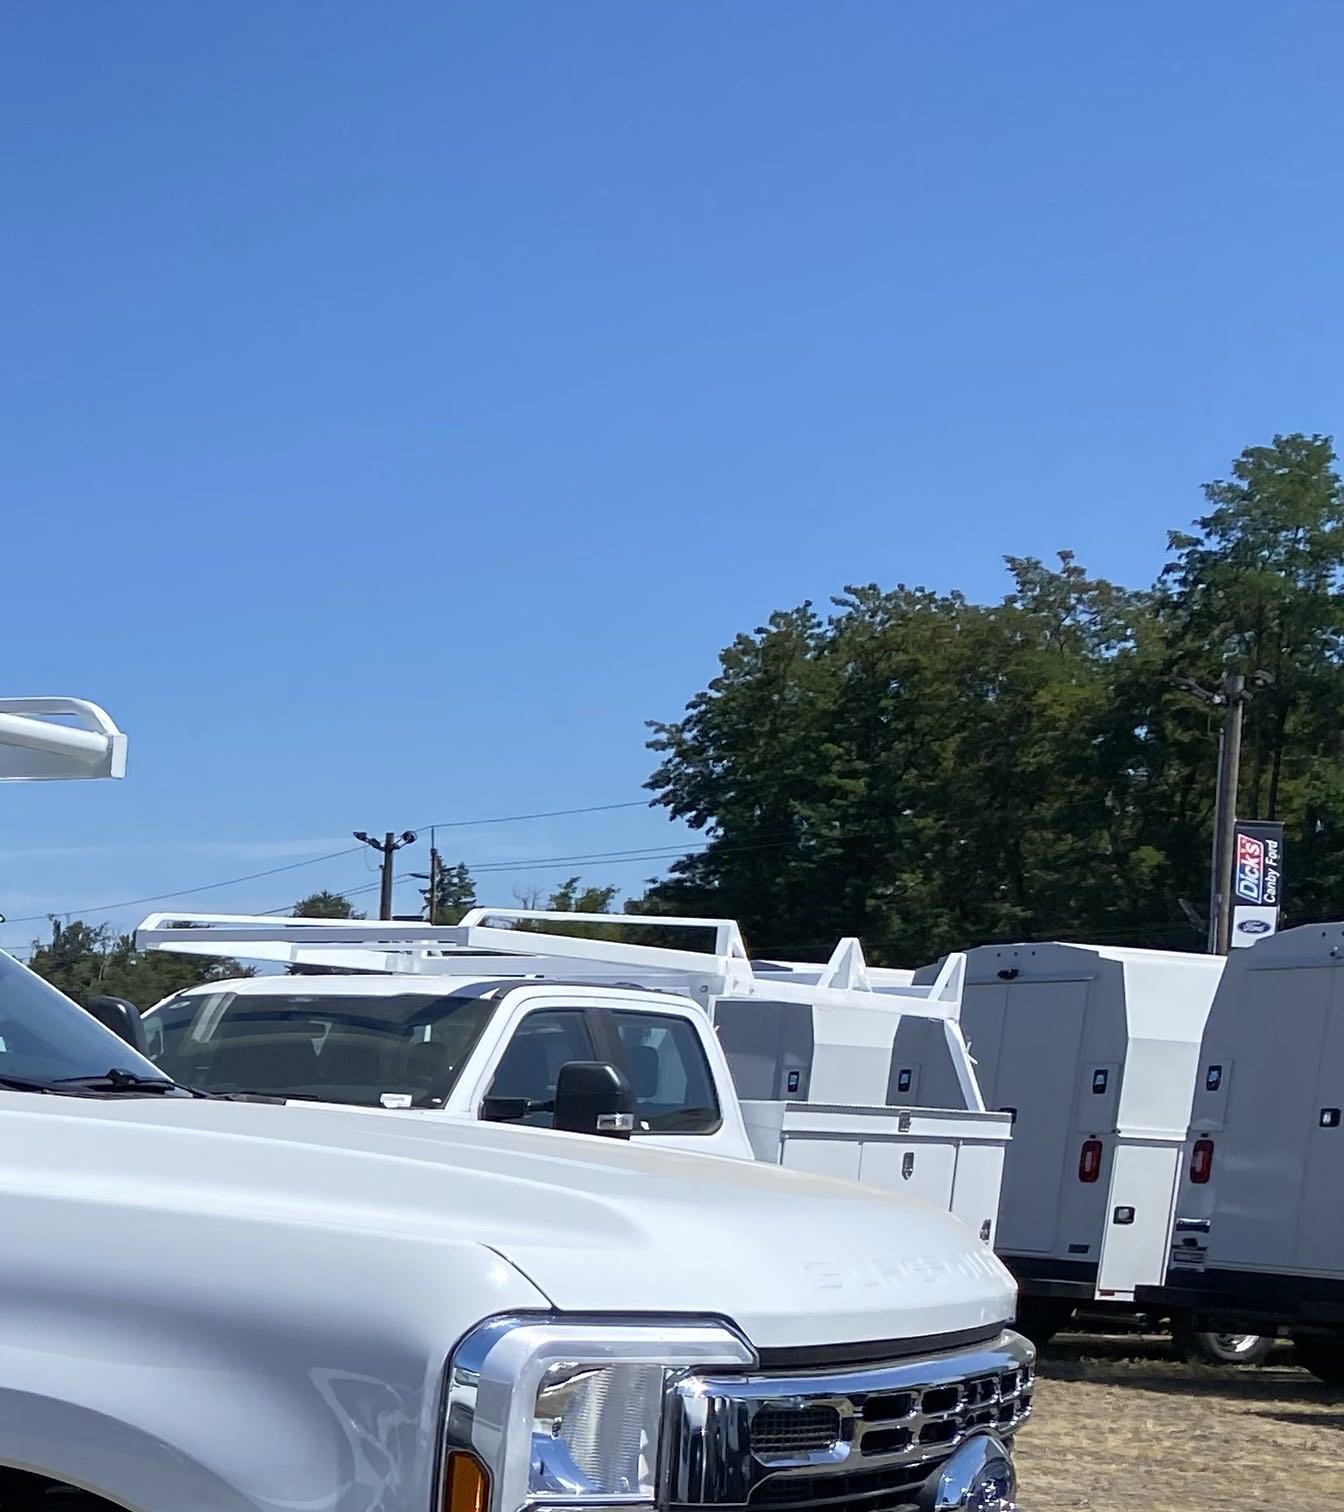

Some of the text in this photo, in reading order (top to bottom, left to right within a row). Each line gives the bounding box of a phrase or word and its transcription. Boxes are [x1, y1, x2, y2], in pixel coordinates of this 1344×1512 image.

[1239, 838, 1260, 898] Dick's
[1264, 839, 1280, 903] Canby Ford
